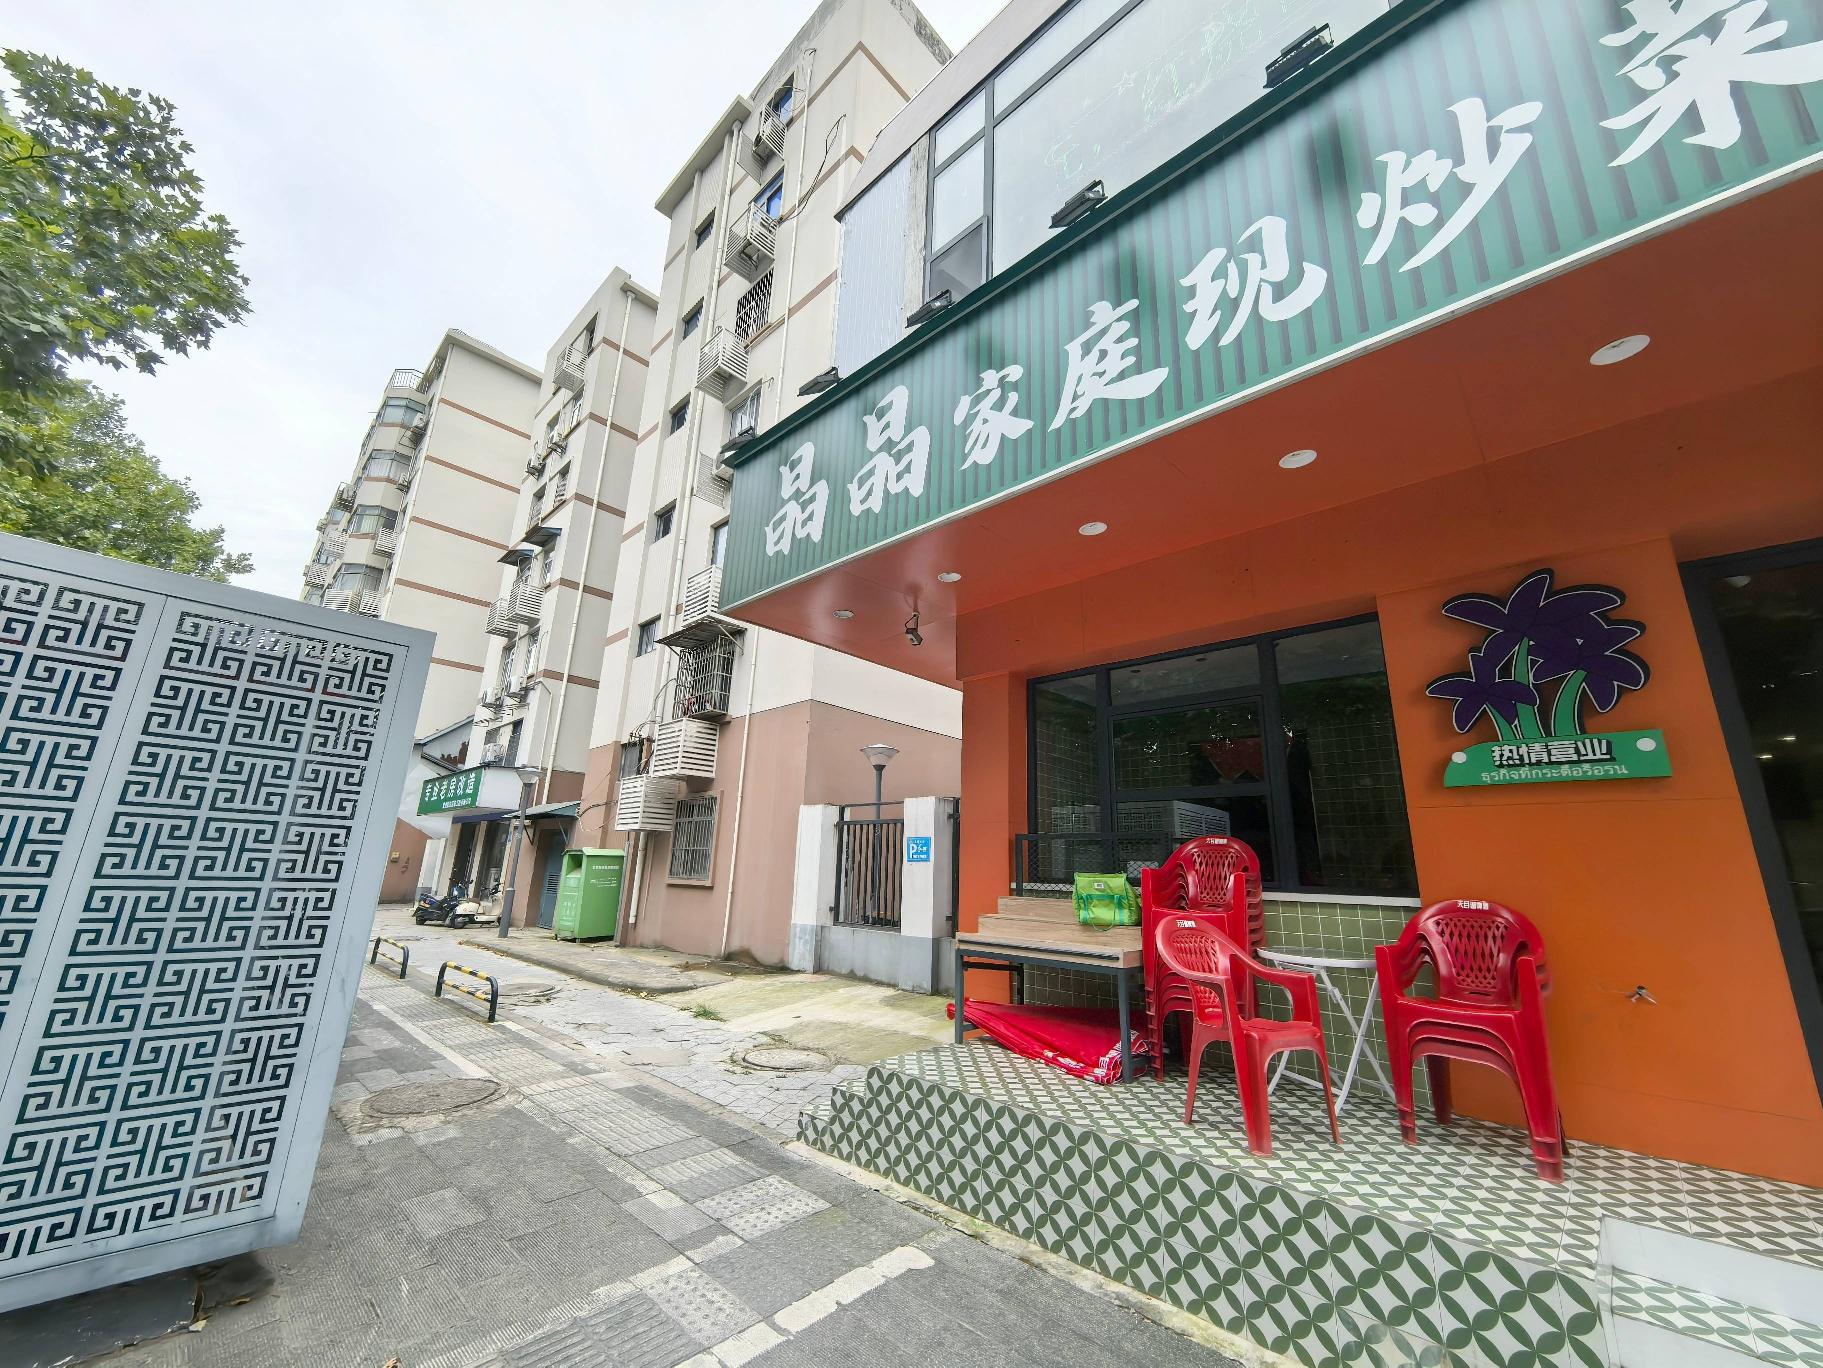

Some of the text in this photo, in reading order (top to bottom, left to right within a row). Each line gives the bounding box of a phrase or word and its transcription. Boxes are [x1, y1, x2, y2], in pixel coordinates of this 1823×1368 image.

[765, 0, 1823, 556] 晶晶家庭现炒菜
[1491, 738, 1611, 766] 热情营业
[425, 772, 476, 803] 专业老房改造
